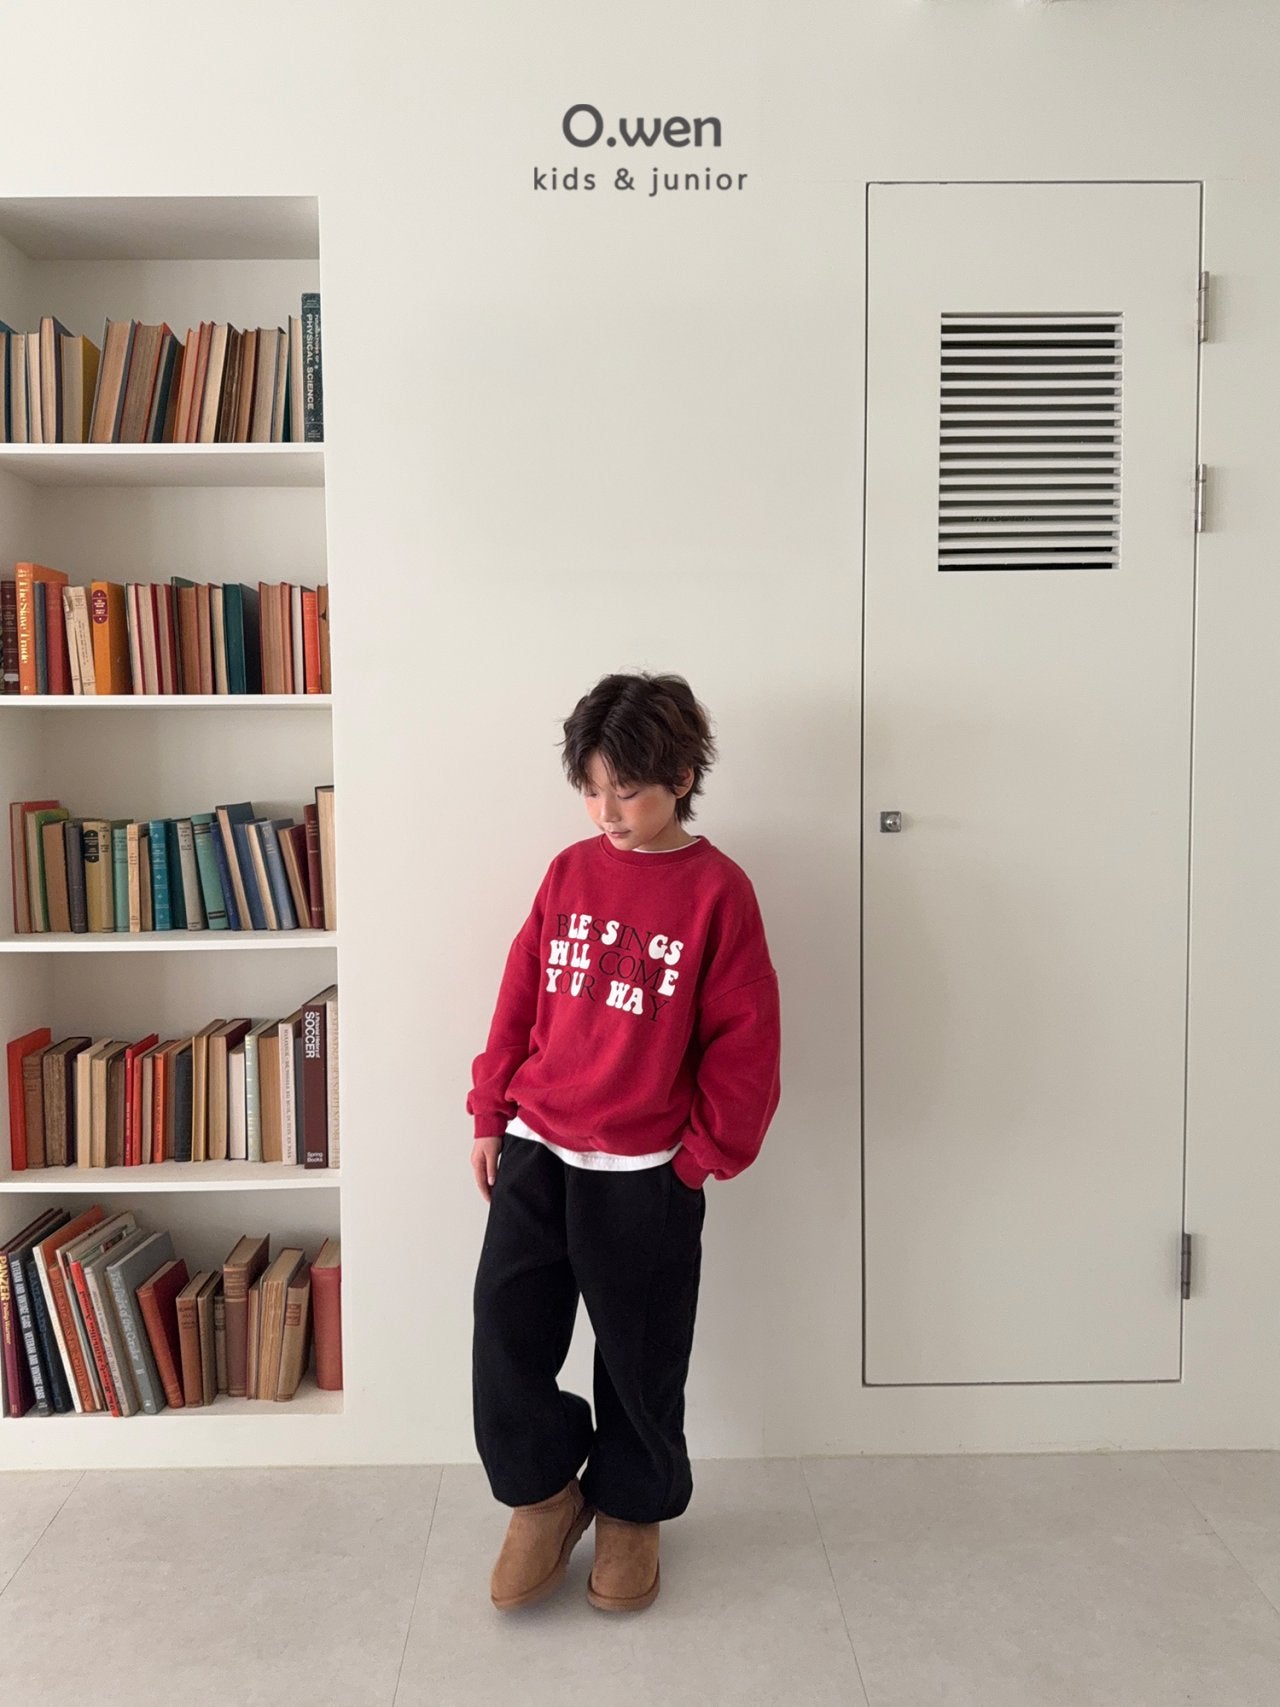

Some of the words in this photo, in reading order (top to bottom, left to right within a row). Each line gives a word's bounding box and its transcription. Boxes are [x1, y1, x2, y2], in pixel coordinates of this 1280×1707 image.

[306, 314, 314, 364] PHYSICAL
[19, 582, 28, 602] The
[557, 913, 684, 966] BLESSINGS
[599, 951, 679, 996] COME
[546, 968, 596, 1001] YOUR
[606, 980, 669, 1022] WAY
[304, 1011, 316, 1059] SOCCER
[0, 1255, 10, 1301] PANZER
[11, 1260, 23, 1283] VETERAN
[15, 1283, 25, 1295] AND
[17, 1294, 29, 1315] VINTAGE
[24, 1331, 37, 1355] VETERAN
[28, 1354, 39, 1366] AND
[31, 1365, 43, 1387] VINTAGE
